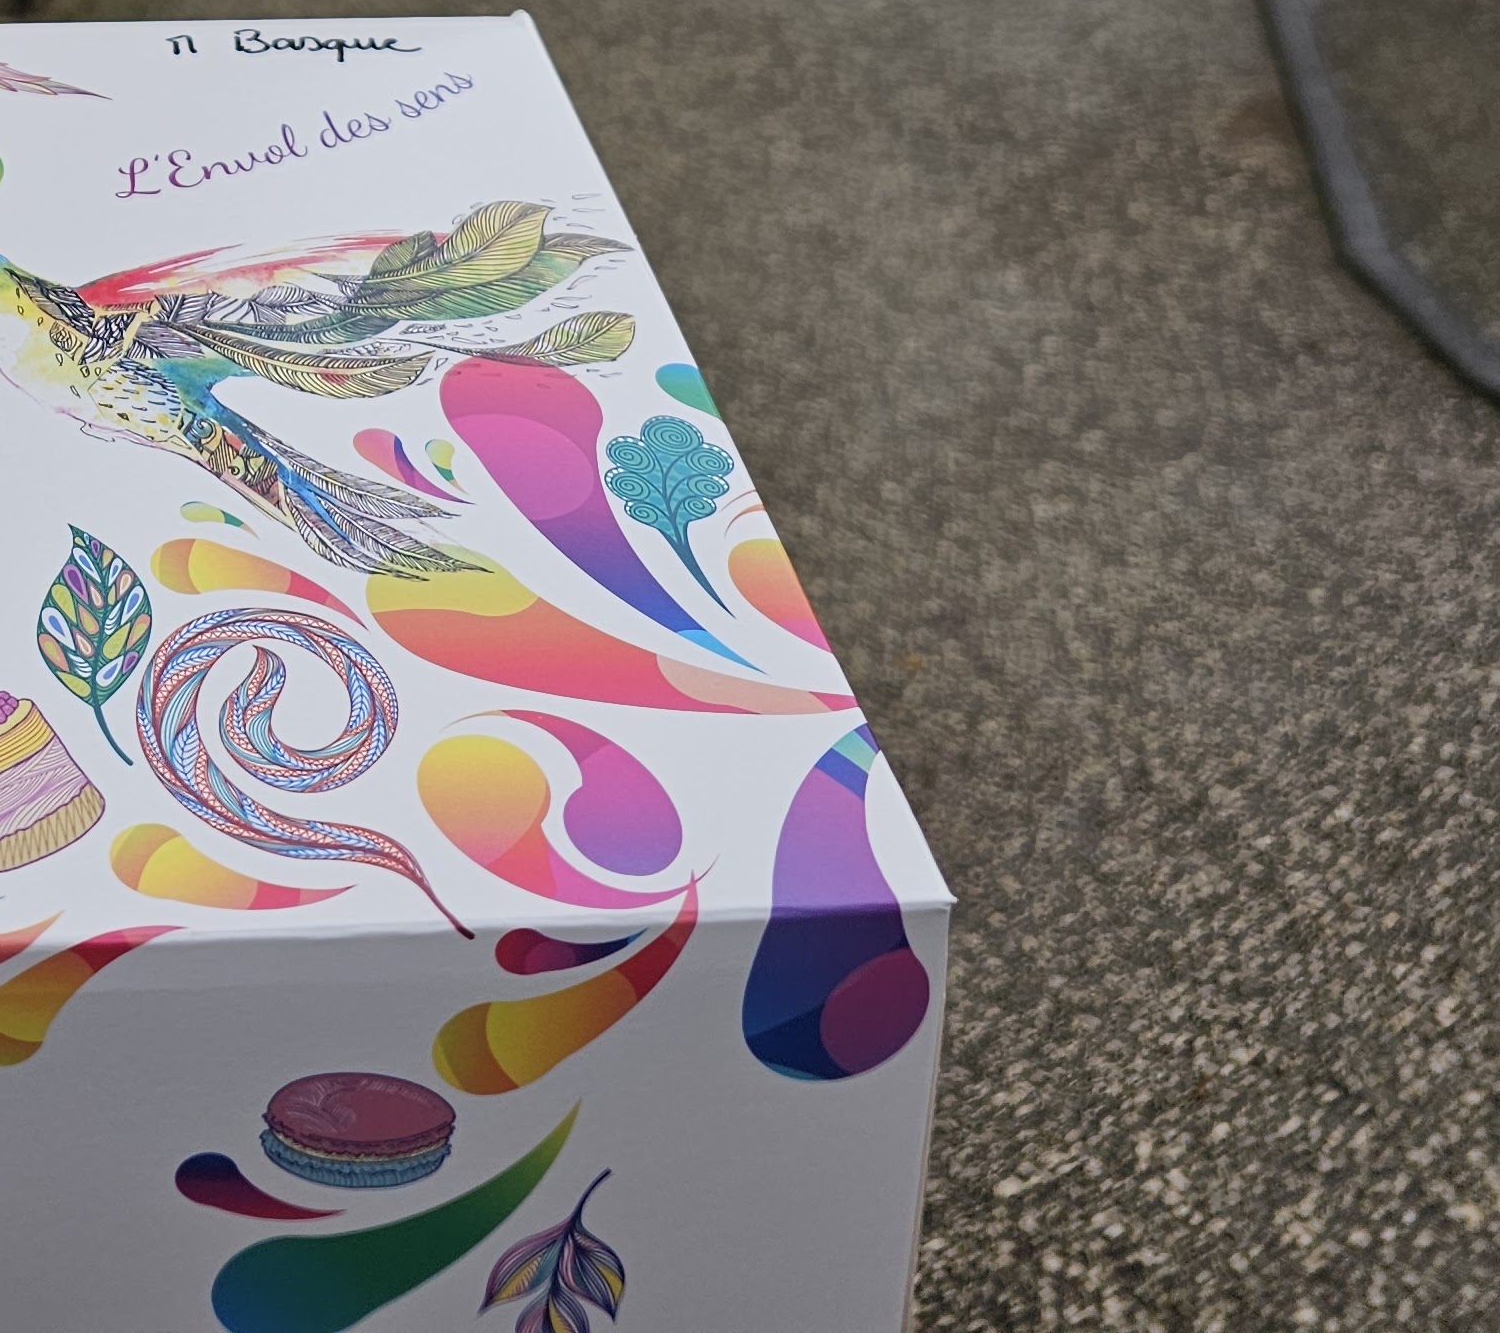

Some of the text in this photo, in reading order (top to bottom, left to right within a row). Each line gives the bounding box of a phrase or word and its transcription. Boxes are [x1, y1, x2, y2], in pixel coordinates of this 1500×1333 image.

[233, 28, 422, 63] Basque
[114, 70, 475, 199] L'Envol des sens
